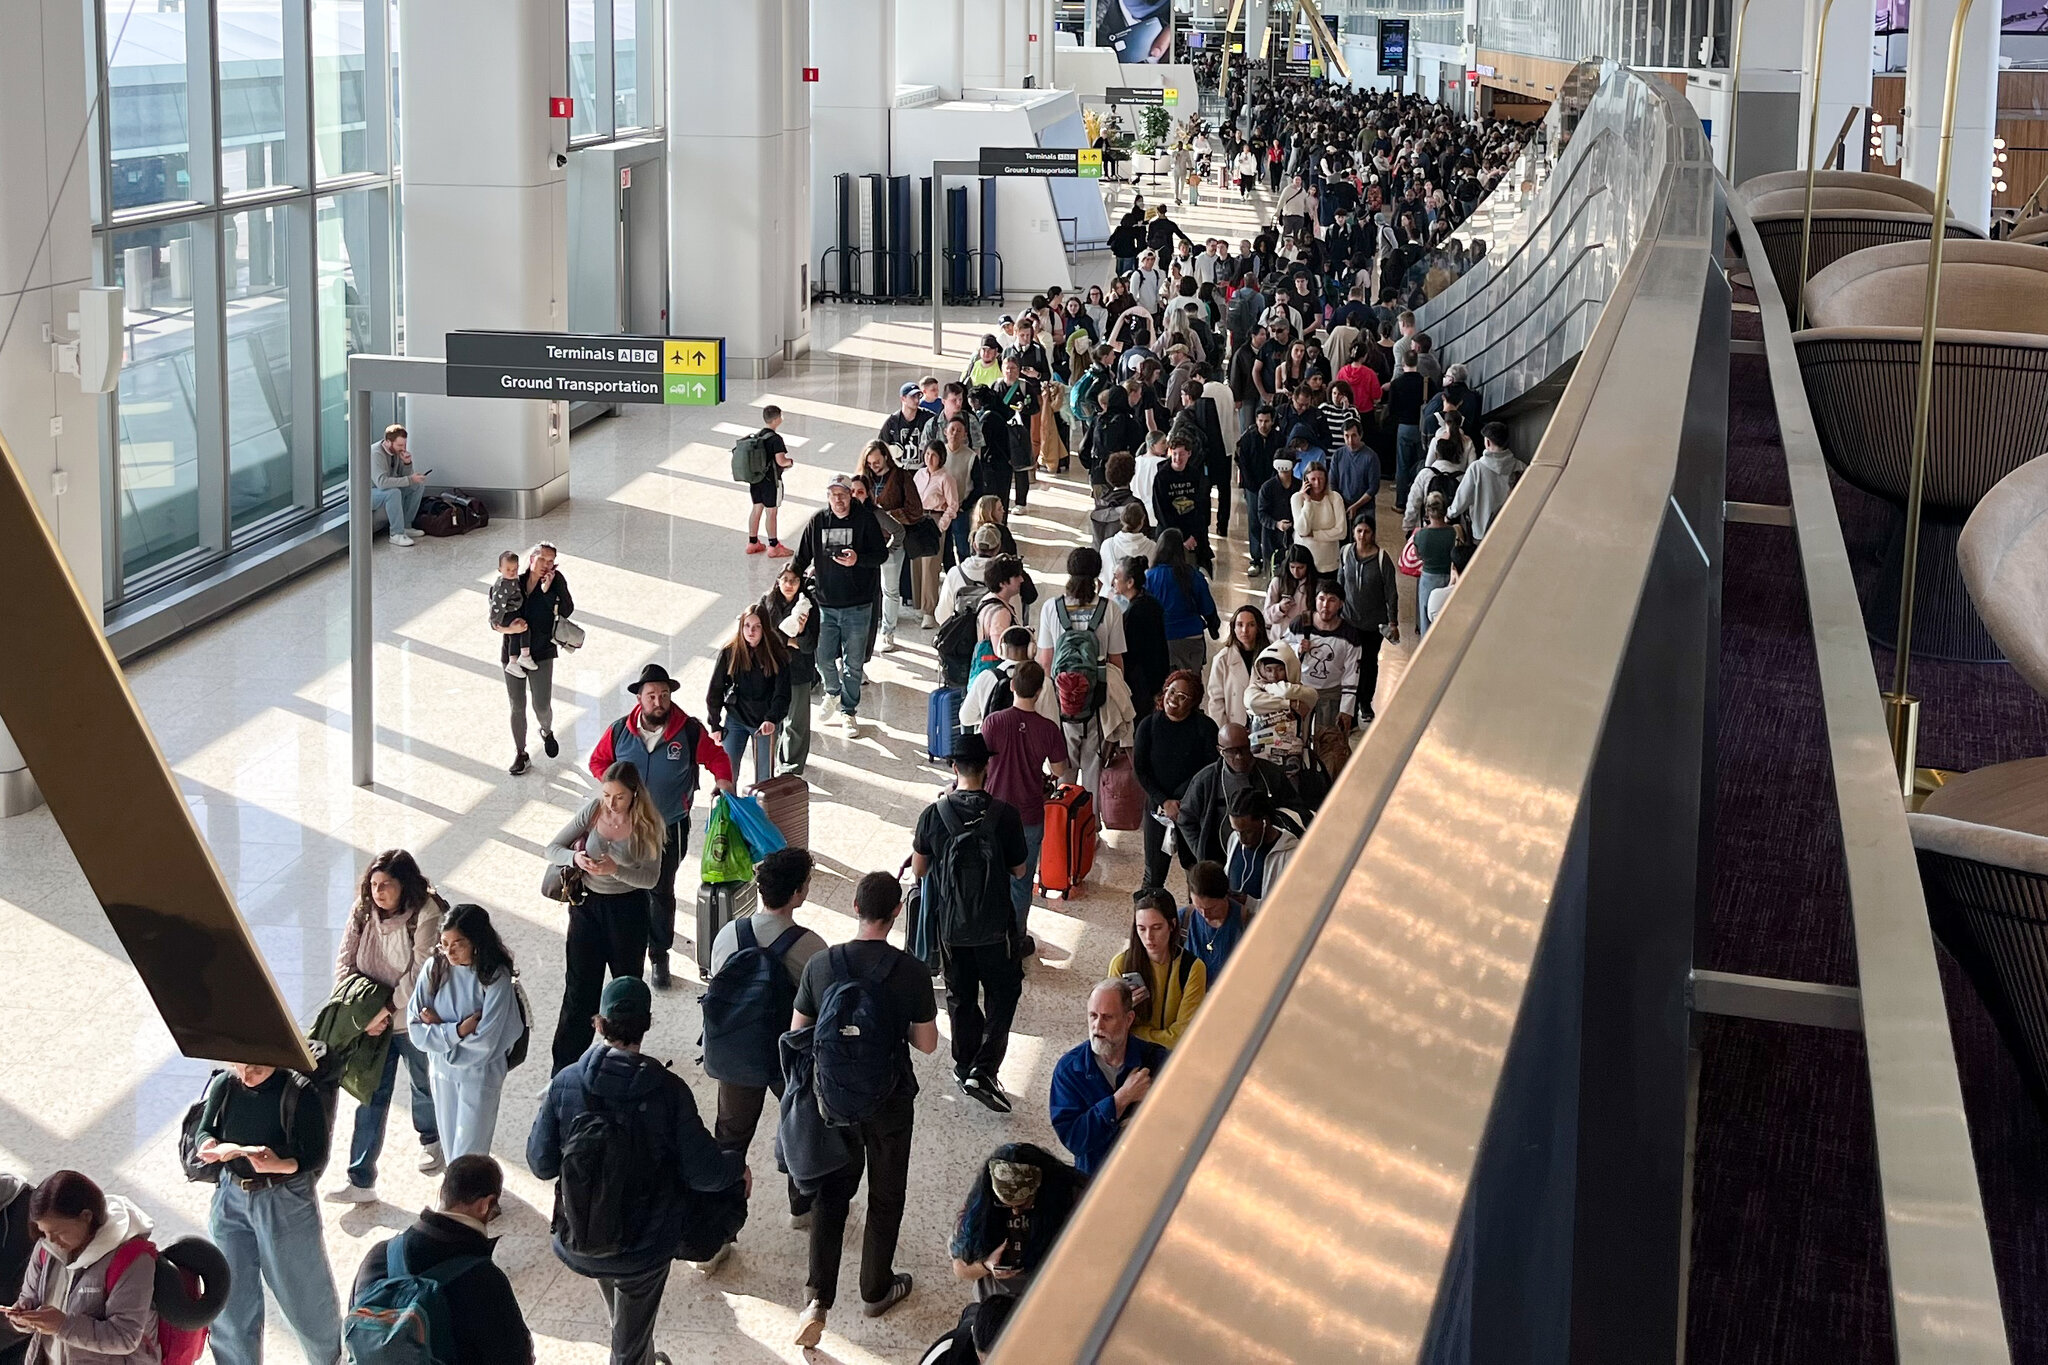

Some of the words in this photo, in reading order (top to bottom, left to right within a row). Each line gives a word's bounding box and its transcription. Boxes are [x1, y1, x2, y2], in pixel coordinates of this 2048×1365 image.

[1025, 152, 1057, 160] Terminals
[1004, 166, 1029, 174] Ground
[1030, 167, 1076, 175] Transportation
[546, 346, 615, 361] Terminals
[501, 375, 552, 389] Ground
[556, 377, 658, 394] Transportation
